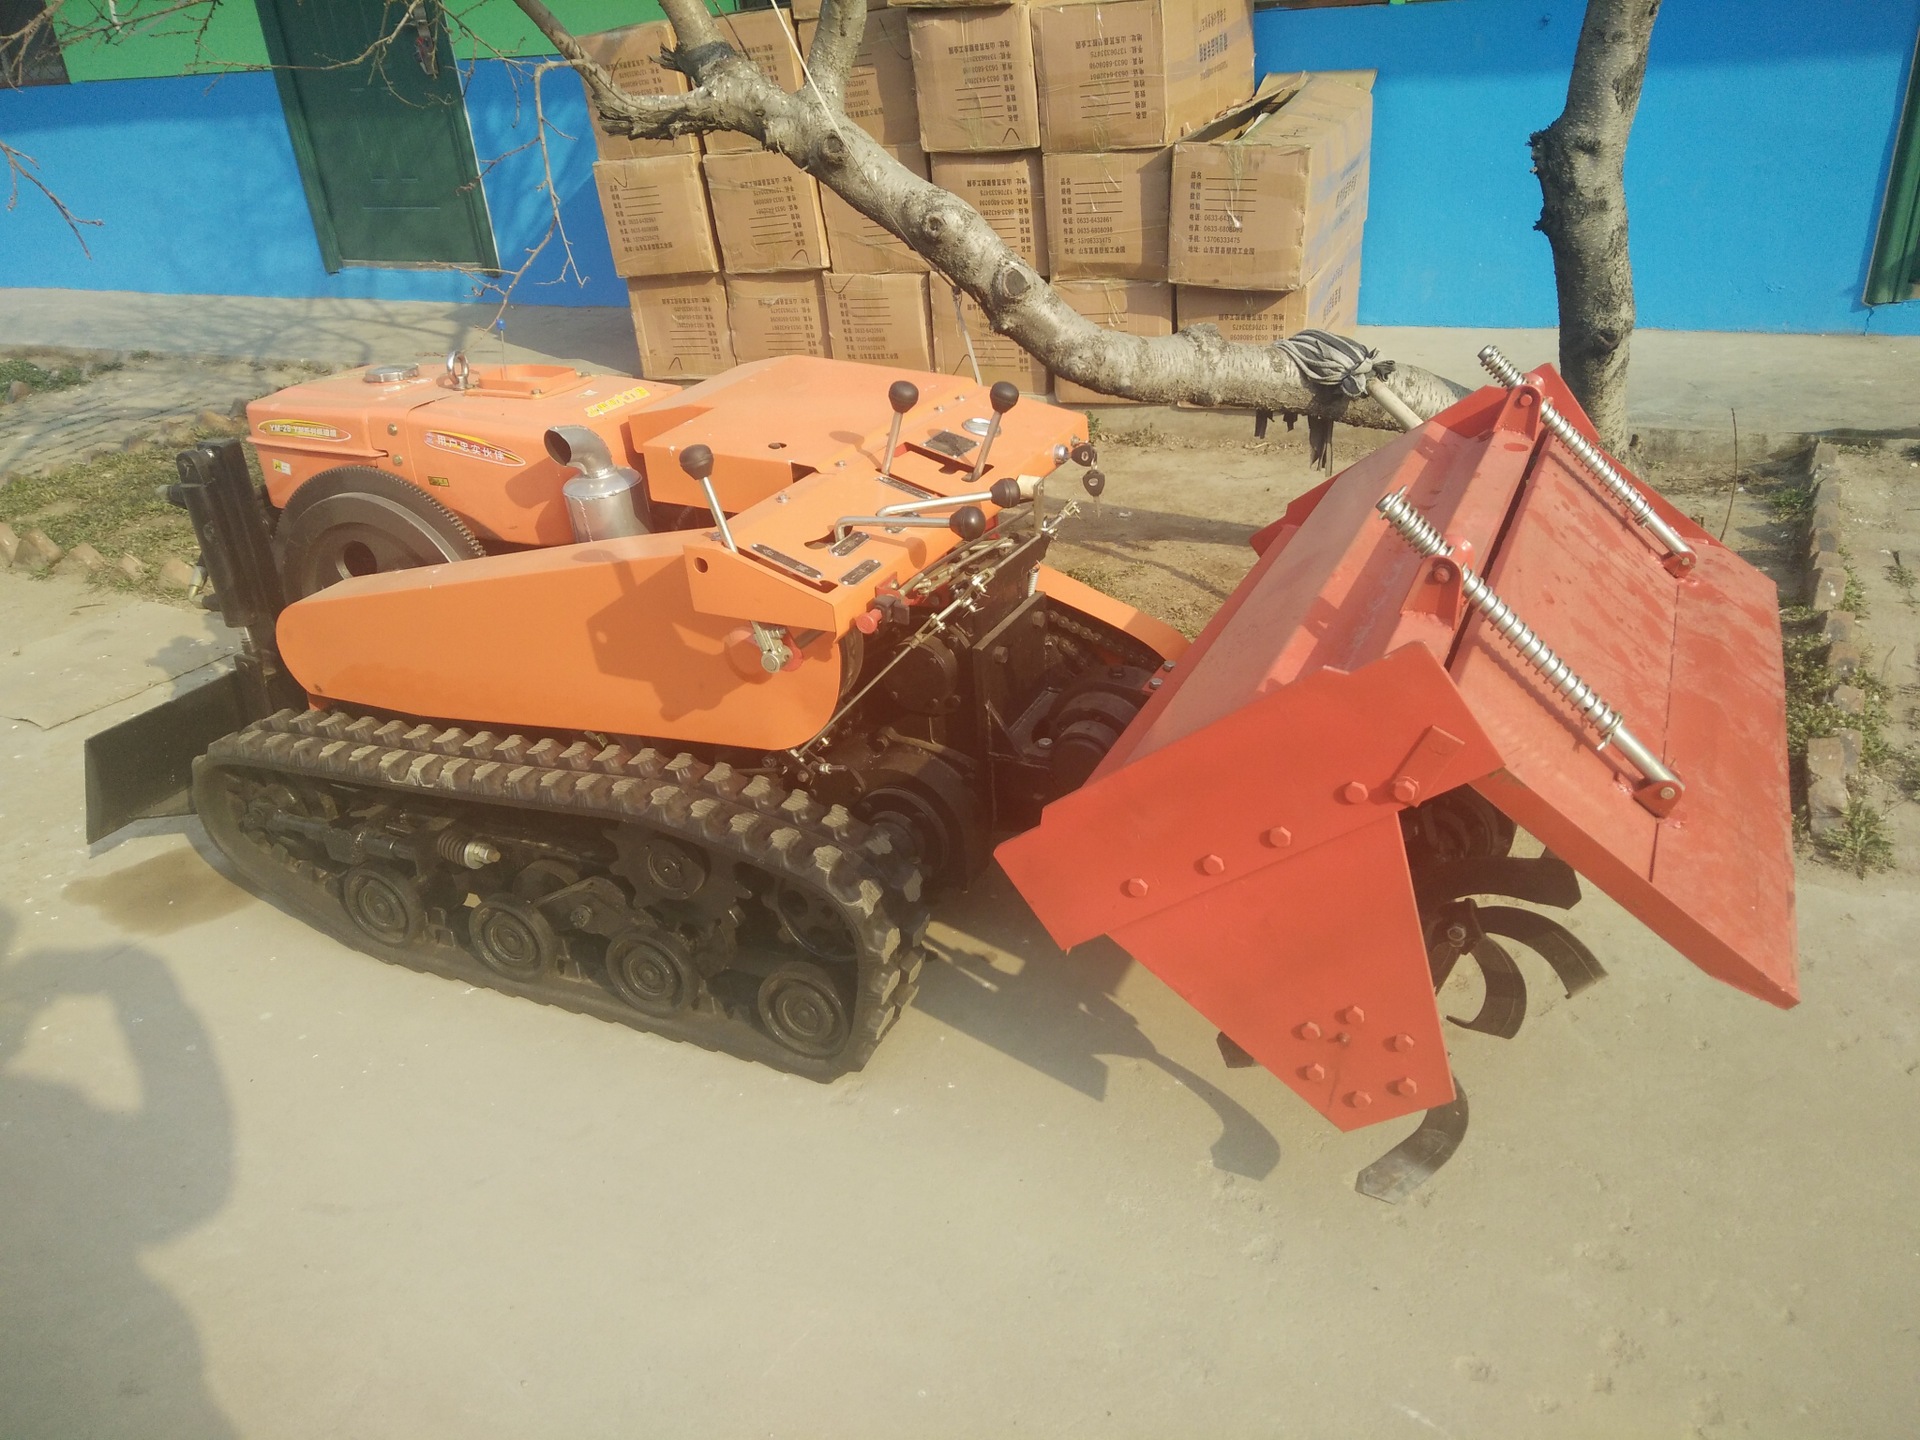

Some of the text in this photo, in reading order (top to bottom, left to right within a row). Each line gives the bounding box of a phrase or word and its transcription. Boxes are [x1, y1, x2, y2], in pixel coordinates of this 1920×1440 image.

[437, 434, 505, 461] 用户忠实伙伴
